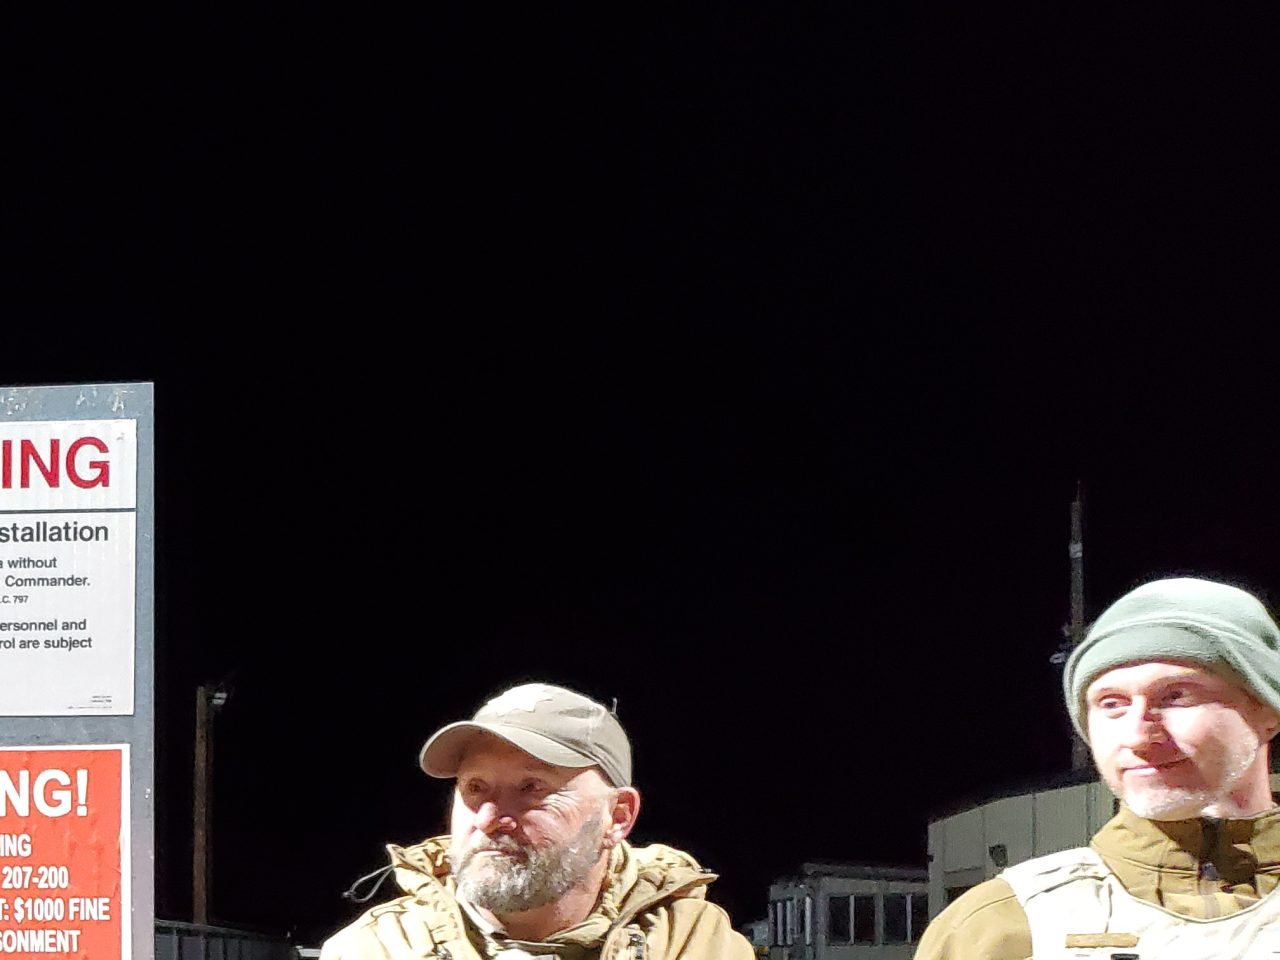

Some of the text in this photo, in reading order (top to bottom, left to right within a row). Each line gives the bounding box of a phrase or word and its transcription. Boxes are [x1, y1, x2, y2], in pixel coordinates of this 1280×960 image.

[8, 557, 57, 568] without
[5, 575, 90, 587] Commander.
[62, 619, 86, 630] and
[19, 640, 40, 648] are
[44, 637, 92, 651] subject
[2, 866, 68, 888] 207-200
[14, 898, 64, 922] $1000
[69, 898, 110, 920] FINE
